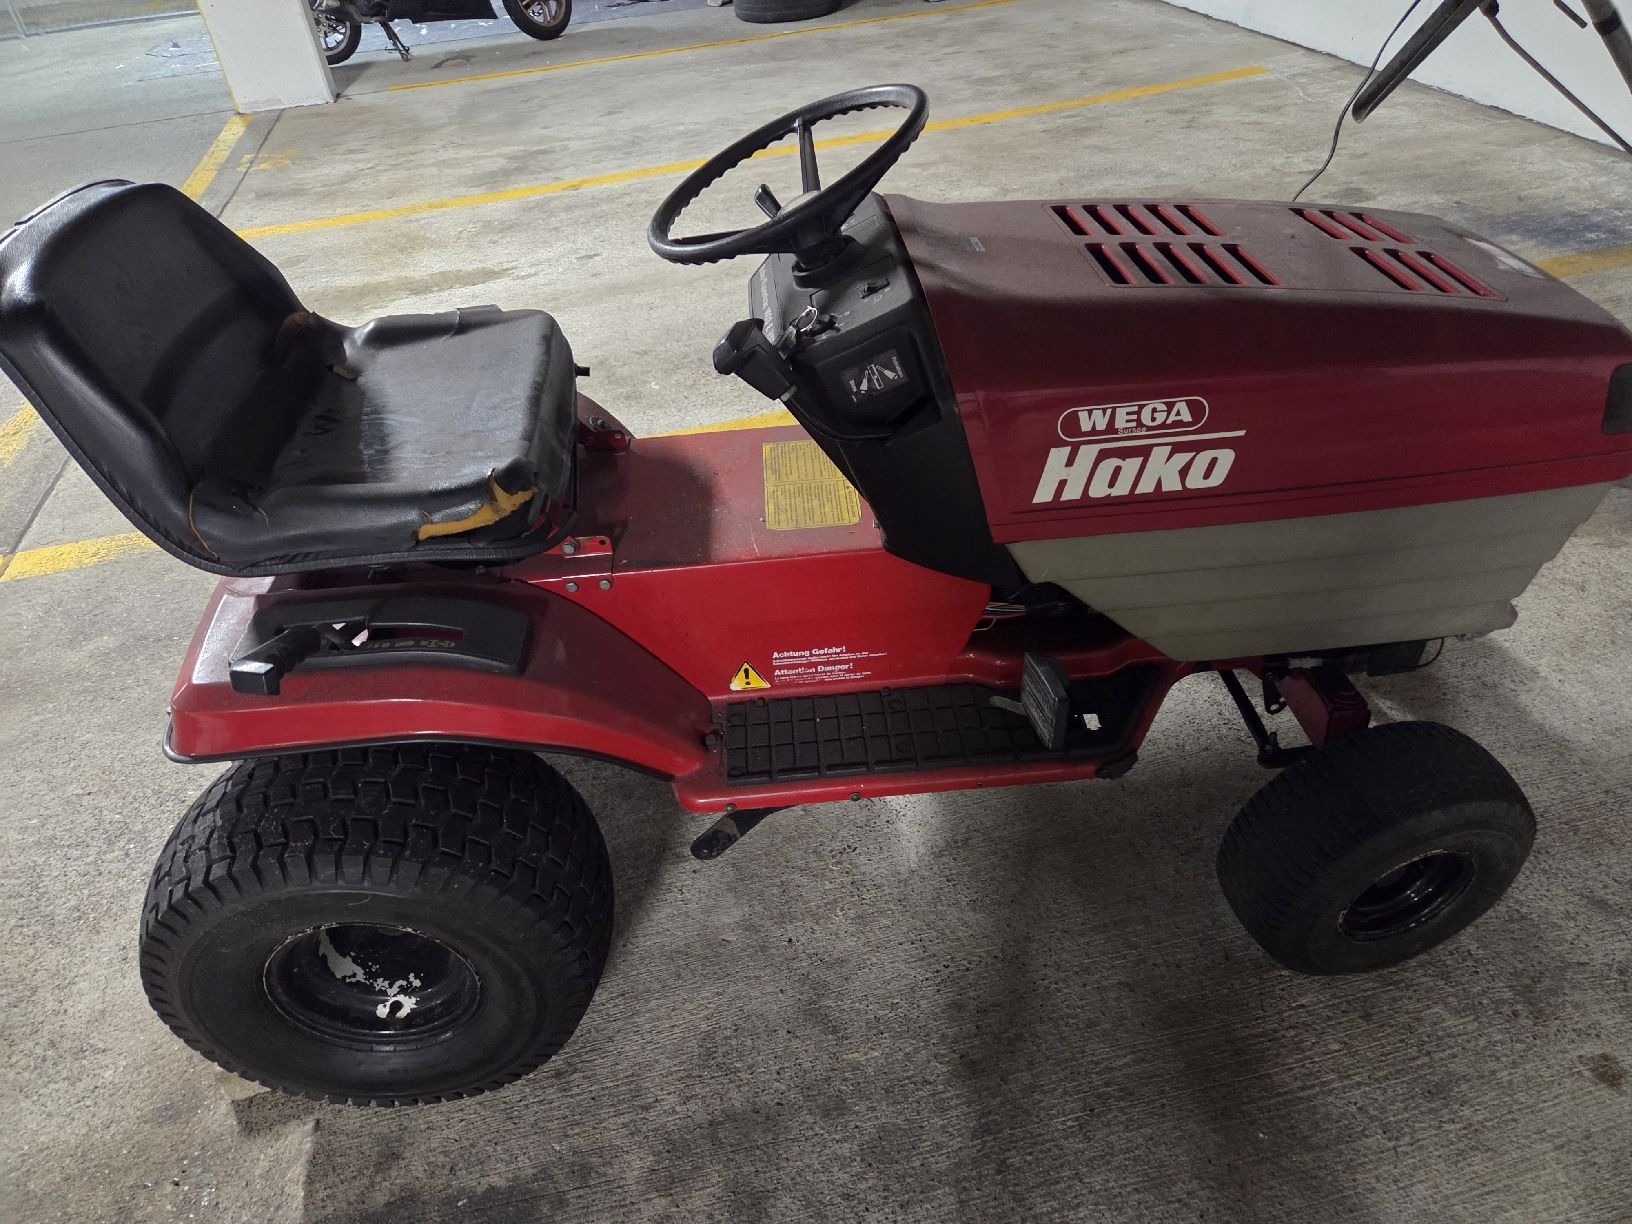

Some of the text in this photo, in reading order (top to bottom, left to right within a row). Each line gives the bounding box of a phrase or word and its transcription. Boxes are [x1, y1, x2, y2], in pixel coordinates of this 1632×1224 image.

[1077, 401, 1194, 433] WEGA
[1031, 444, 1237, 504] Hako
[772, 649, 810, 659] Achtung
[811, 645, 846, 655] Gefahr!
[774, 662, 853, 676] Attention Danger!
